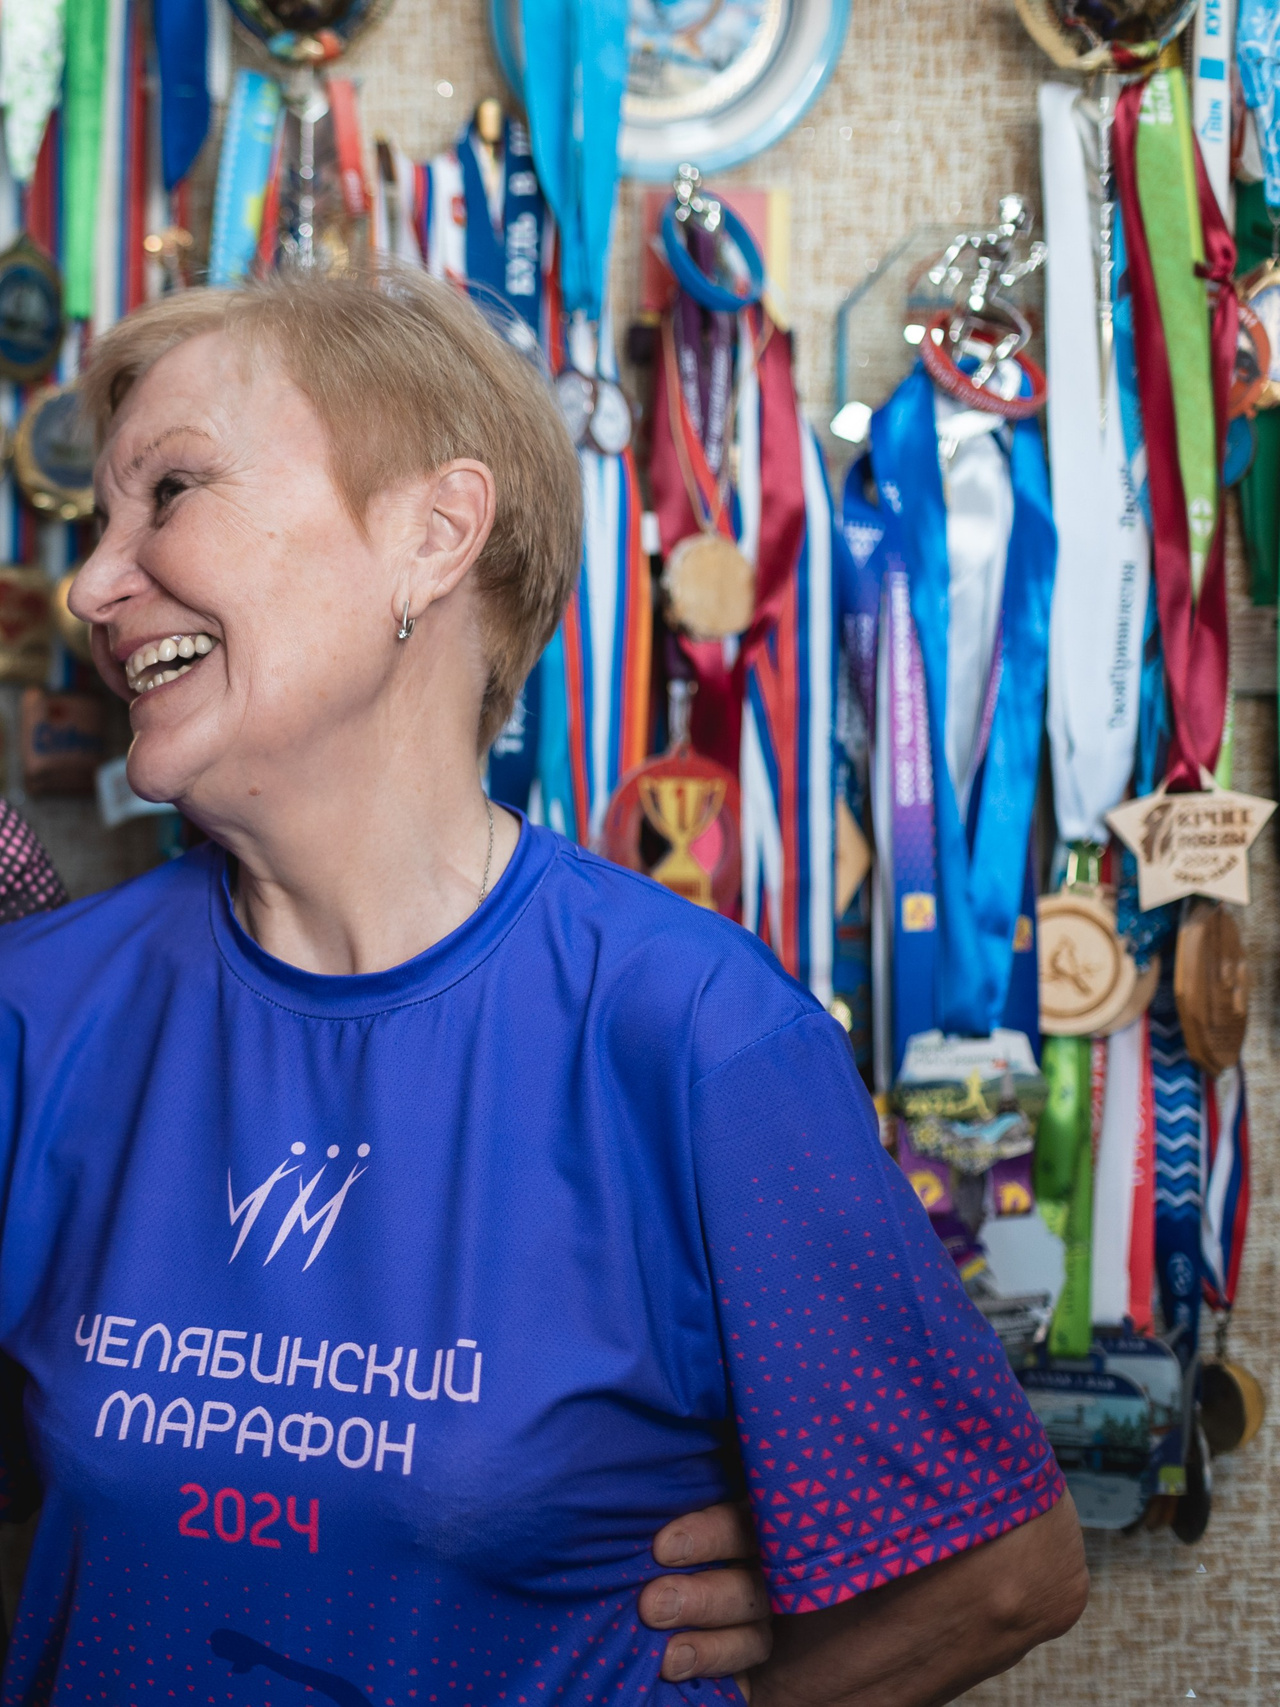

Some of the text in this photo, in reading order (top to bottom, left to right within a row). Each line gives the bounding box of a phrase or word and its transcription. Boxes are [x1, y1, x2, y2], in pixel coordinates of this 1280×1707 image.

[75, 1314, 484, 1404] ЧЕЛЯБИНСКИЙ
[94, 1390, 417, 1476] МАРАФОН
[177, 1482, 321, 1555] 2024
